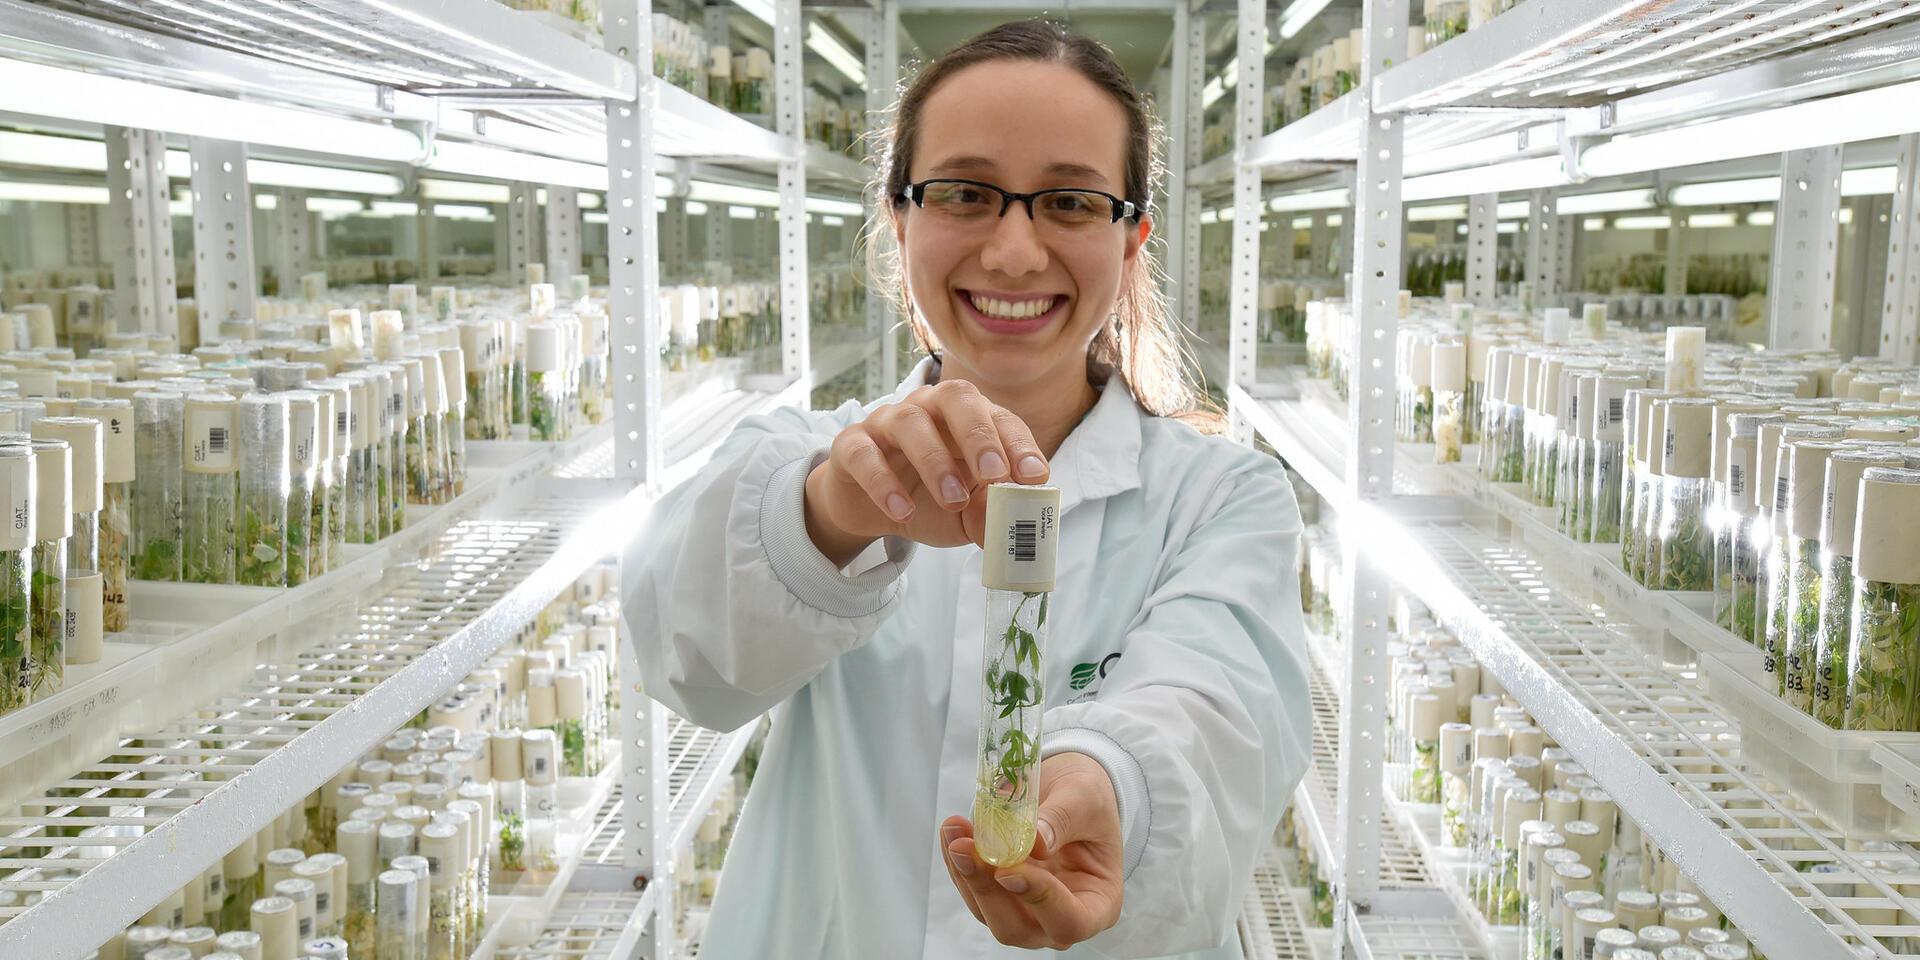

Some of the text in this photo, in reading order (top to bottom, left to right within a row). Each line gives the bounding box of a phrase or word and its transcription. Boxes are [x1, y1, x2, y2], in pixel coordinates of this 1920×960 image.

[15, 507, 24, 530] CIAT
[1046, 506, 1054, 531] CIAT
[1008, 526, 1016, 540] PER
[1787, 673, 1803, 690] B3
[1816, 682, 1829, 701] B3
